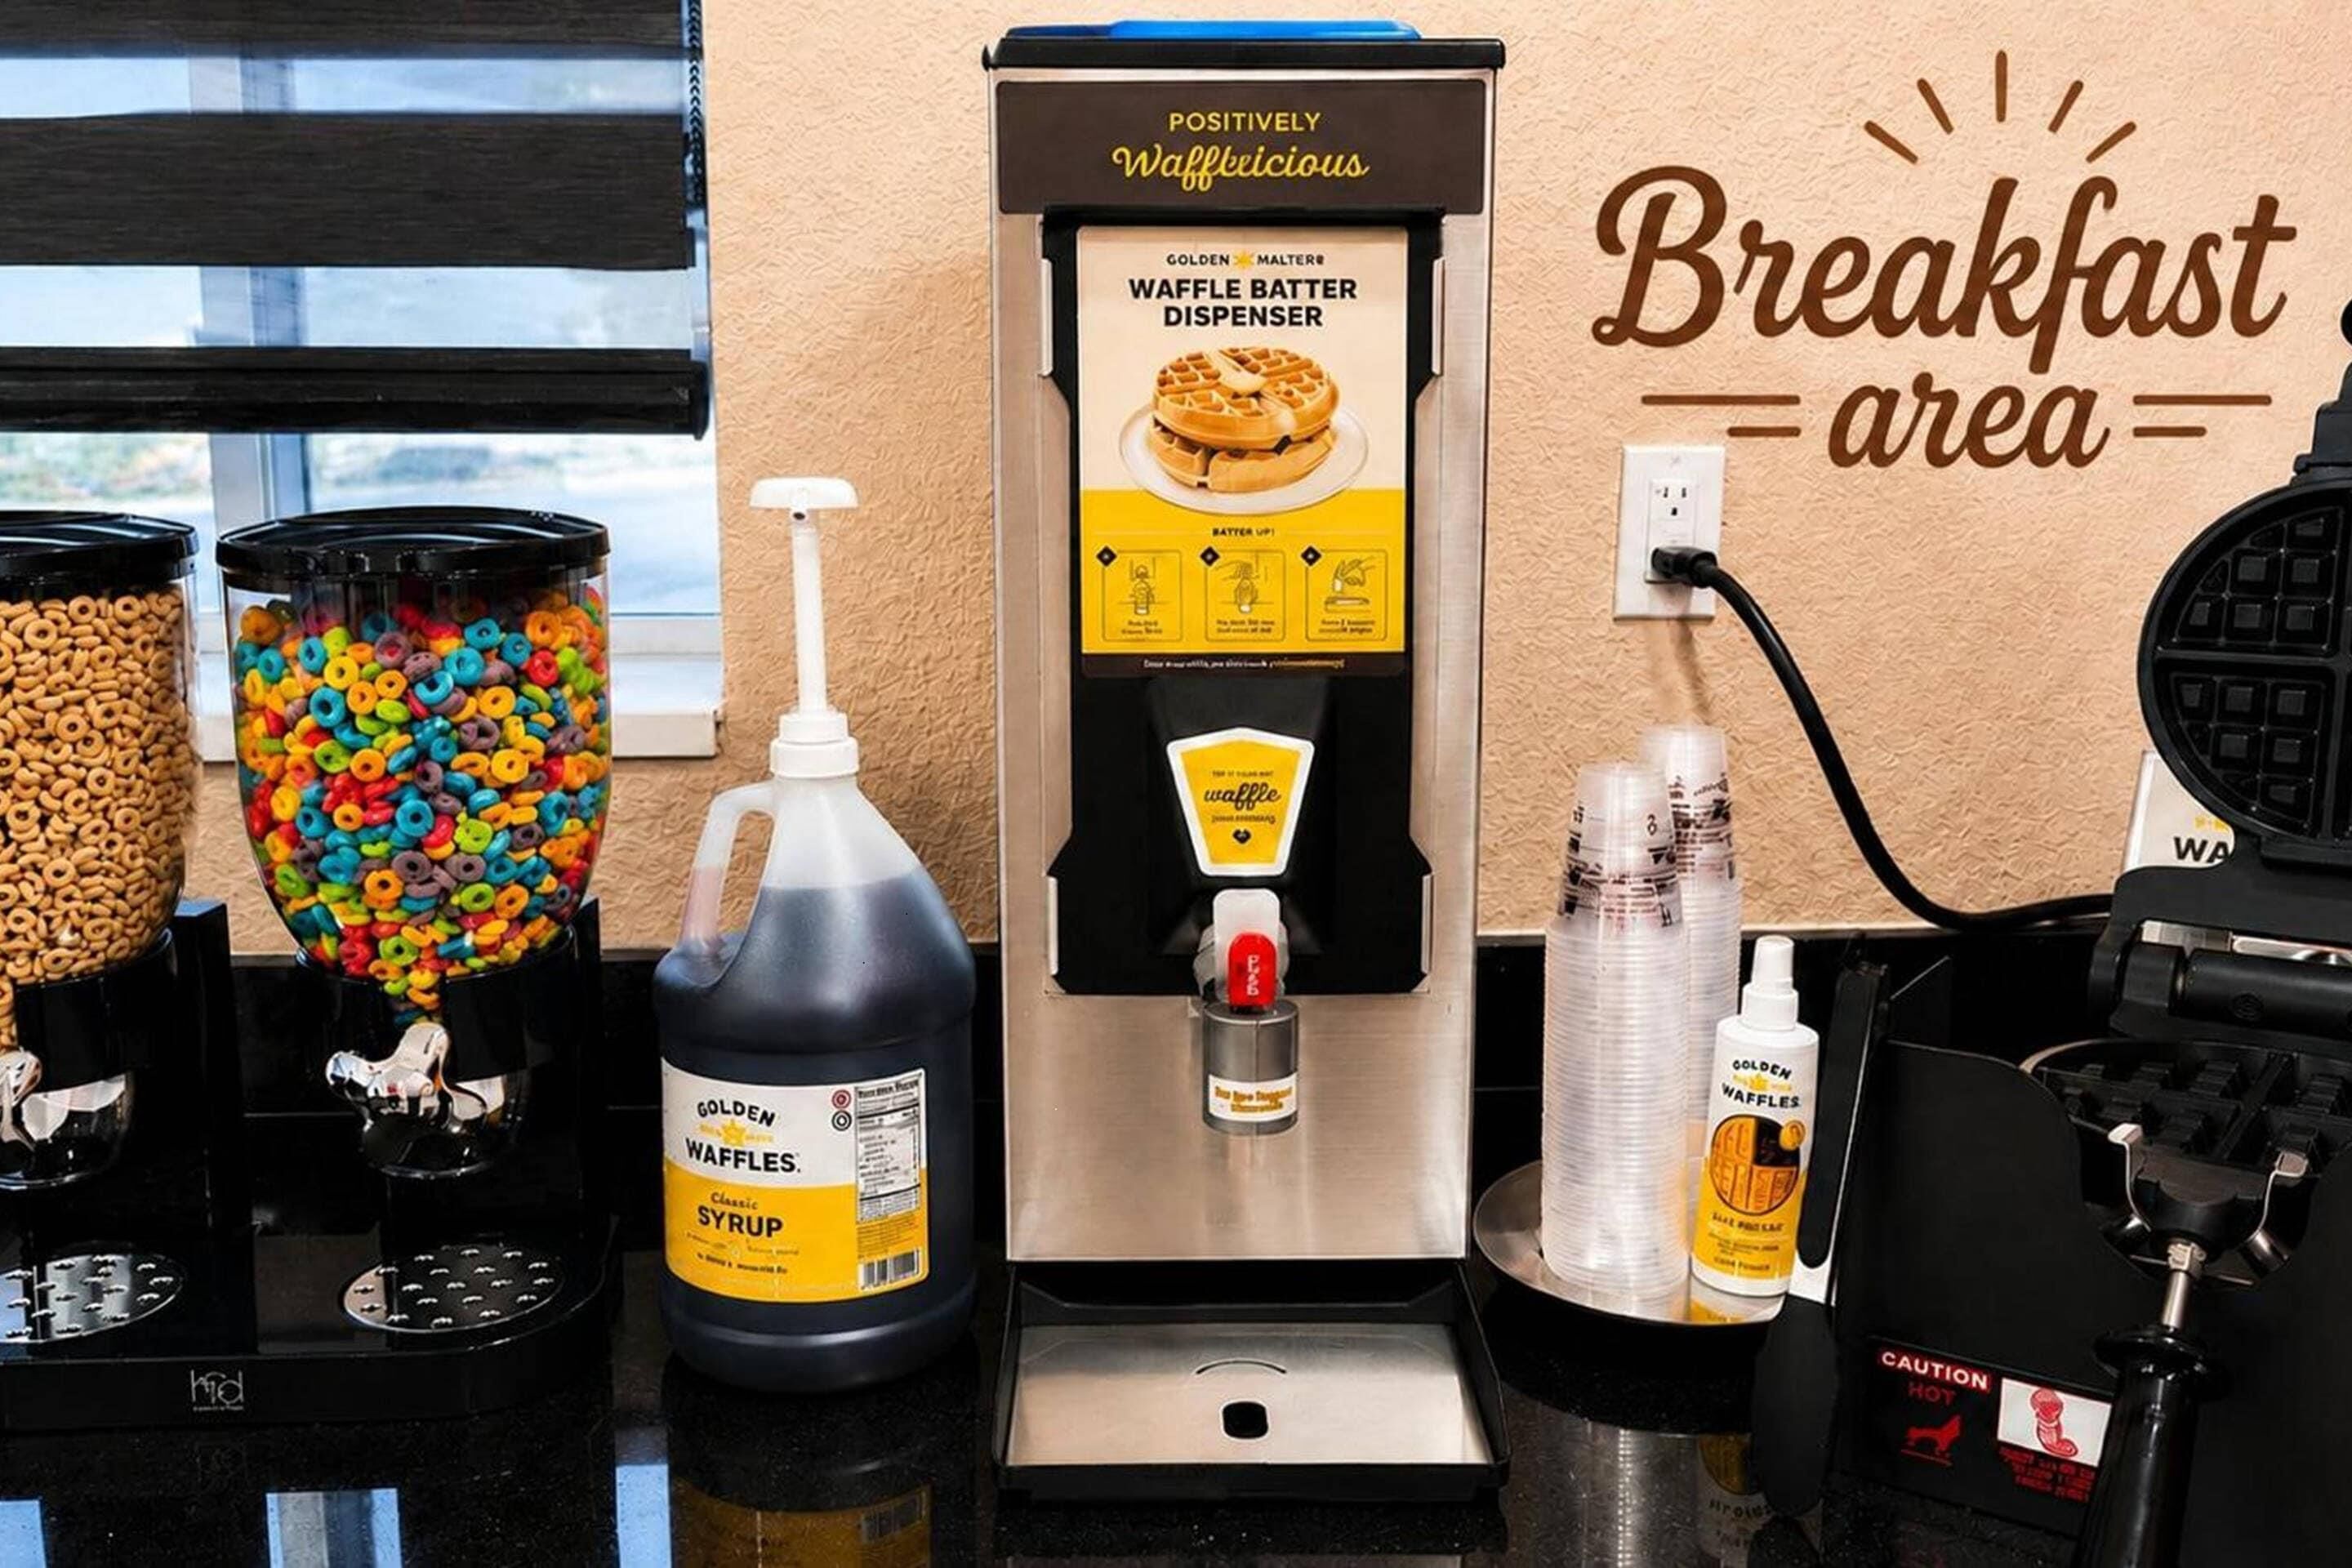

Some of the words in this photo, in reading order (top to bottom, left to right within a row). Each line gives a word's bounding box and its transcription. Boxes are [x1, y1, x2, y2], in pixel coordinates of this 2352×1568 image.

[1169, 111, 1321, 132] POSITIVELY
[1166, 253, 1230, 266] GOLDEN
[1591, 165, 2297, 375] Breakfast
[1129, 278, 1241, 300] WAFFLE
[1250, 278, 1356, 300] BATTER
[1164, 305, 1323, 327] DISPENSER
[1829, 372, 2110, 469] area
[1205, 782, 1281, 811] waffle
[697, 1099, 776, 1127] GOLDEN
[710, 1192, 759, 1210] Classic
[697, 1205, 784, 1238] SYRUP
[1882, 1351, 1989, 1391] CAUTION
[1908, 1382, 1957, 1406] HOT
